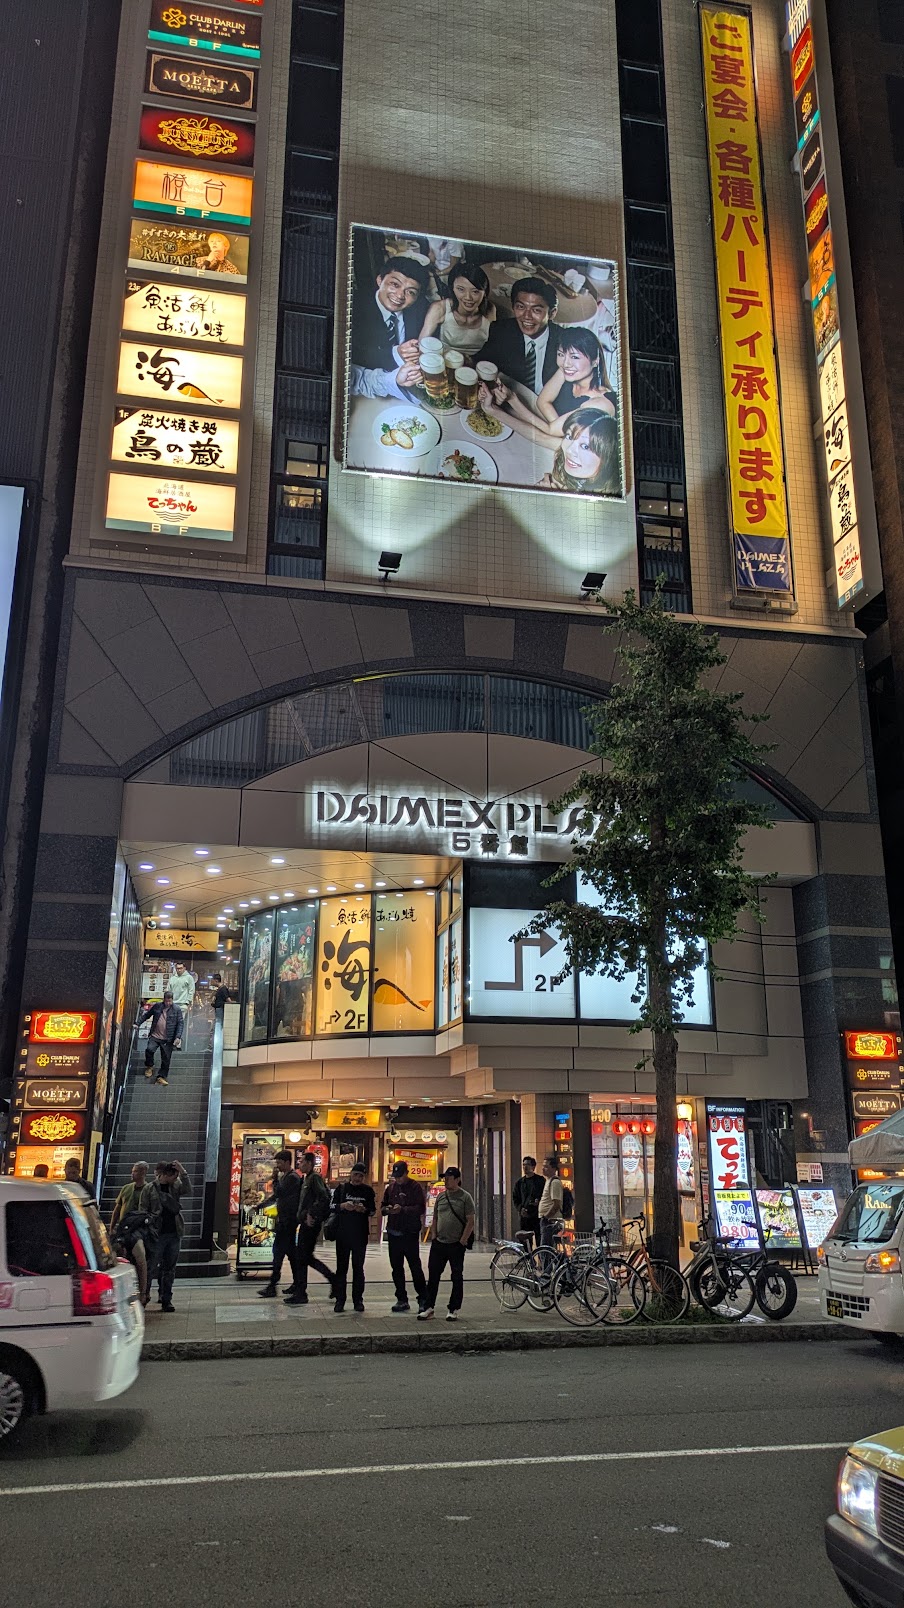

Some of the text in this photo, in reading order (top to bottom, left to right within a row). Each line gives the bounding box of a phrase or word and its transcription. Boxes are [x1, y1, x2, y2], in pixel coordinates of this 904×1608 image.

[189, 14, 246, 31] CLUB DARLIN
[189, 21, 245, 35] SAPPORO
[163, 69, 241, 93] MOETTA
[163, 128, 235, 147] BUNNY HUNT
[141, 245, 198, 267] RAMPAGE
[709, 22, 777, 524] ご宴会・各種パーティ承ります
[156, 314, 229, 343] あぶり焼
[118, 409, 130, 419] 1F
[138, 413, 218, 435] 炭火焼き処
[125, 429, 225, 469] 鳥の蔵
[146, 496, 198, 513] てっちゃん
[737, 550, 787, 564] DAIMEX
[741, 561, 785, 574] PLAZA
[316, 790, 498, 831] DAIMEX
[534, 974, 563, 993] 2F
[344, 1009, 366, 1030] 2F
[32, 1089, 80, 1098] MOETTA
[859, 1100, 897, 1108] MOETTA
